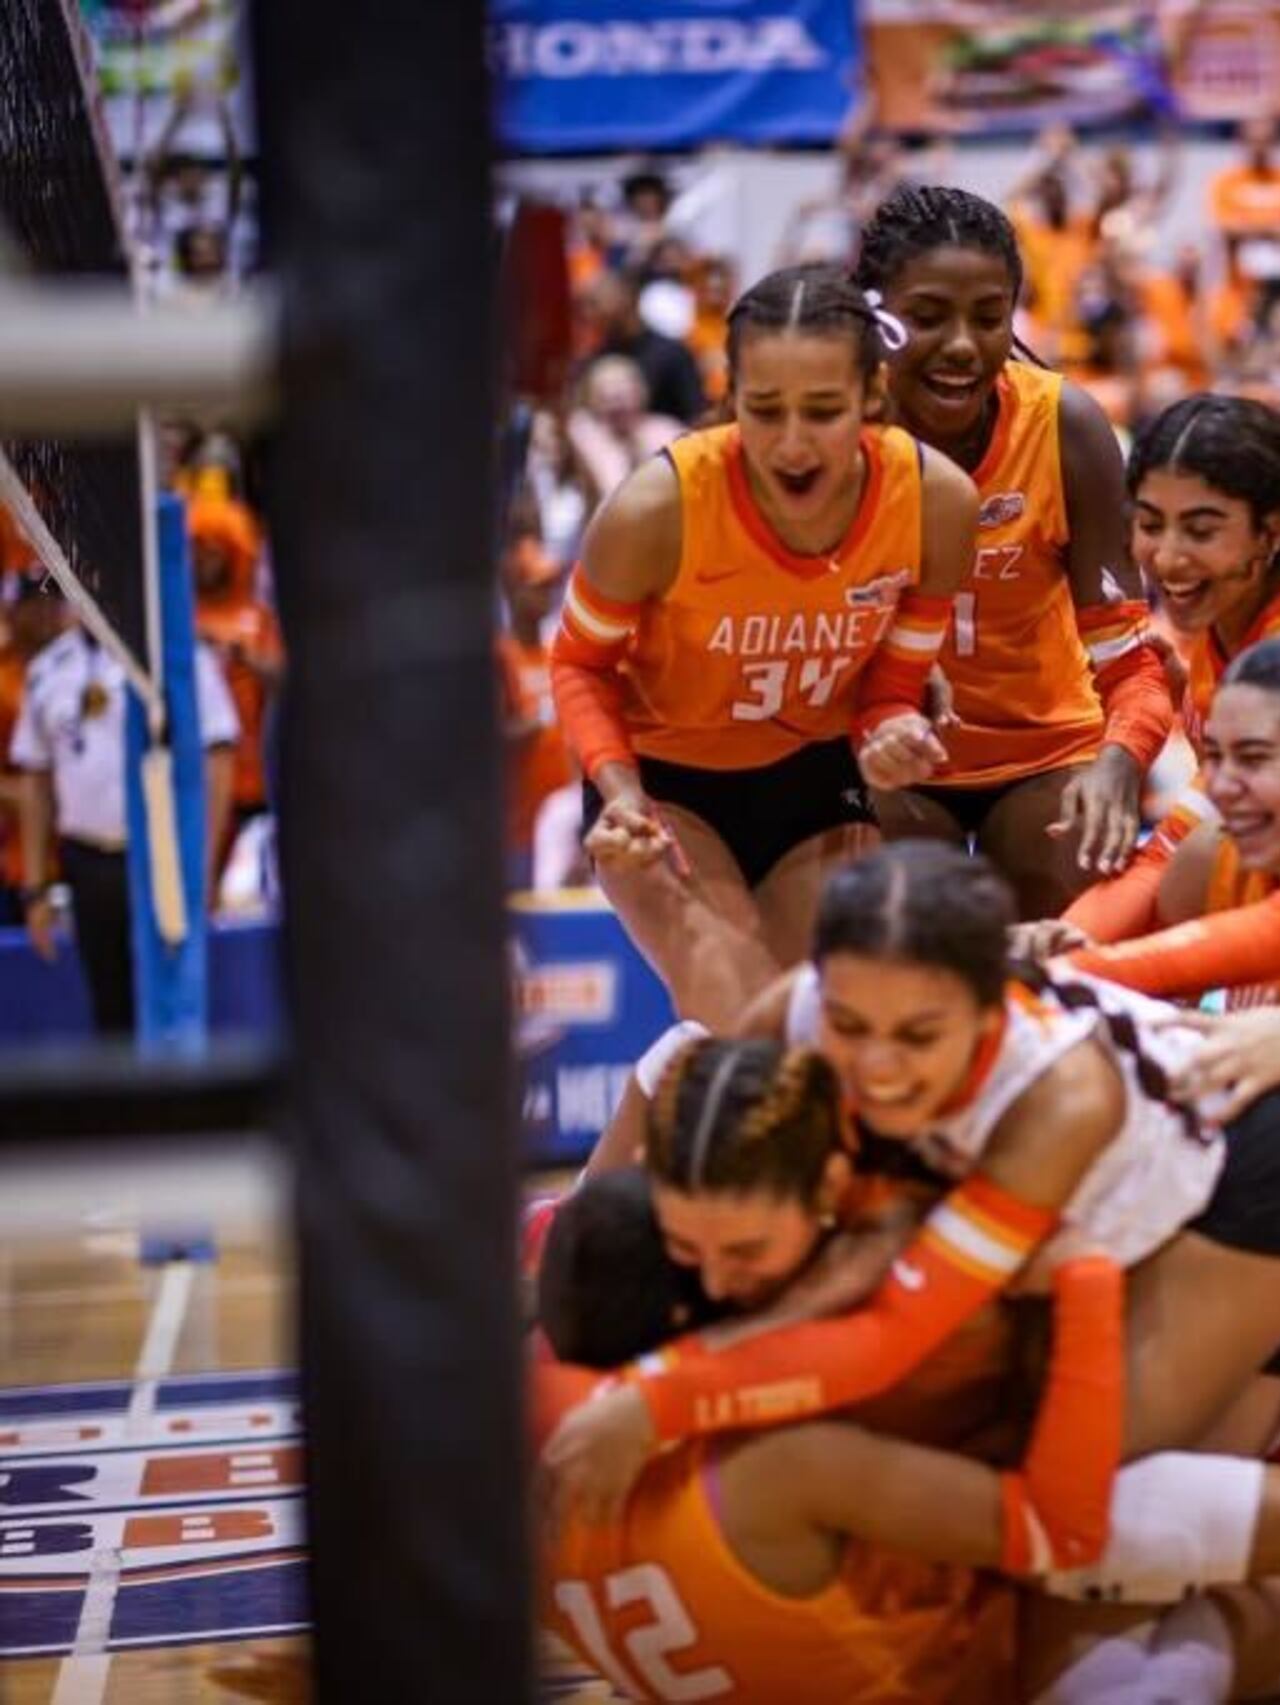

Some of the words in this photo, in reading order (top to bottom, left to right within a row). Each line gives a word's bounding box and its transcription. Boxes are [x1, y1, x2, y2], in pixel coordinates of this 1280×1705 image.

[705, 604, 896, 655] ADIANEZ
[731, 654, 852, 721] 34
[554, 1560, 737, 1704] 12
